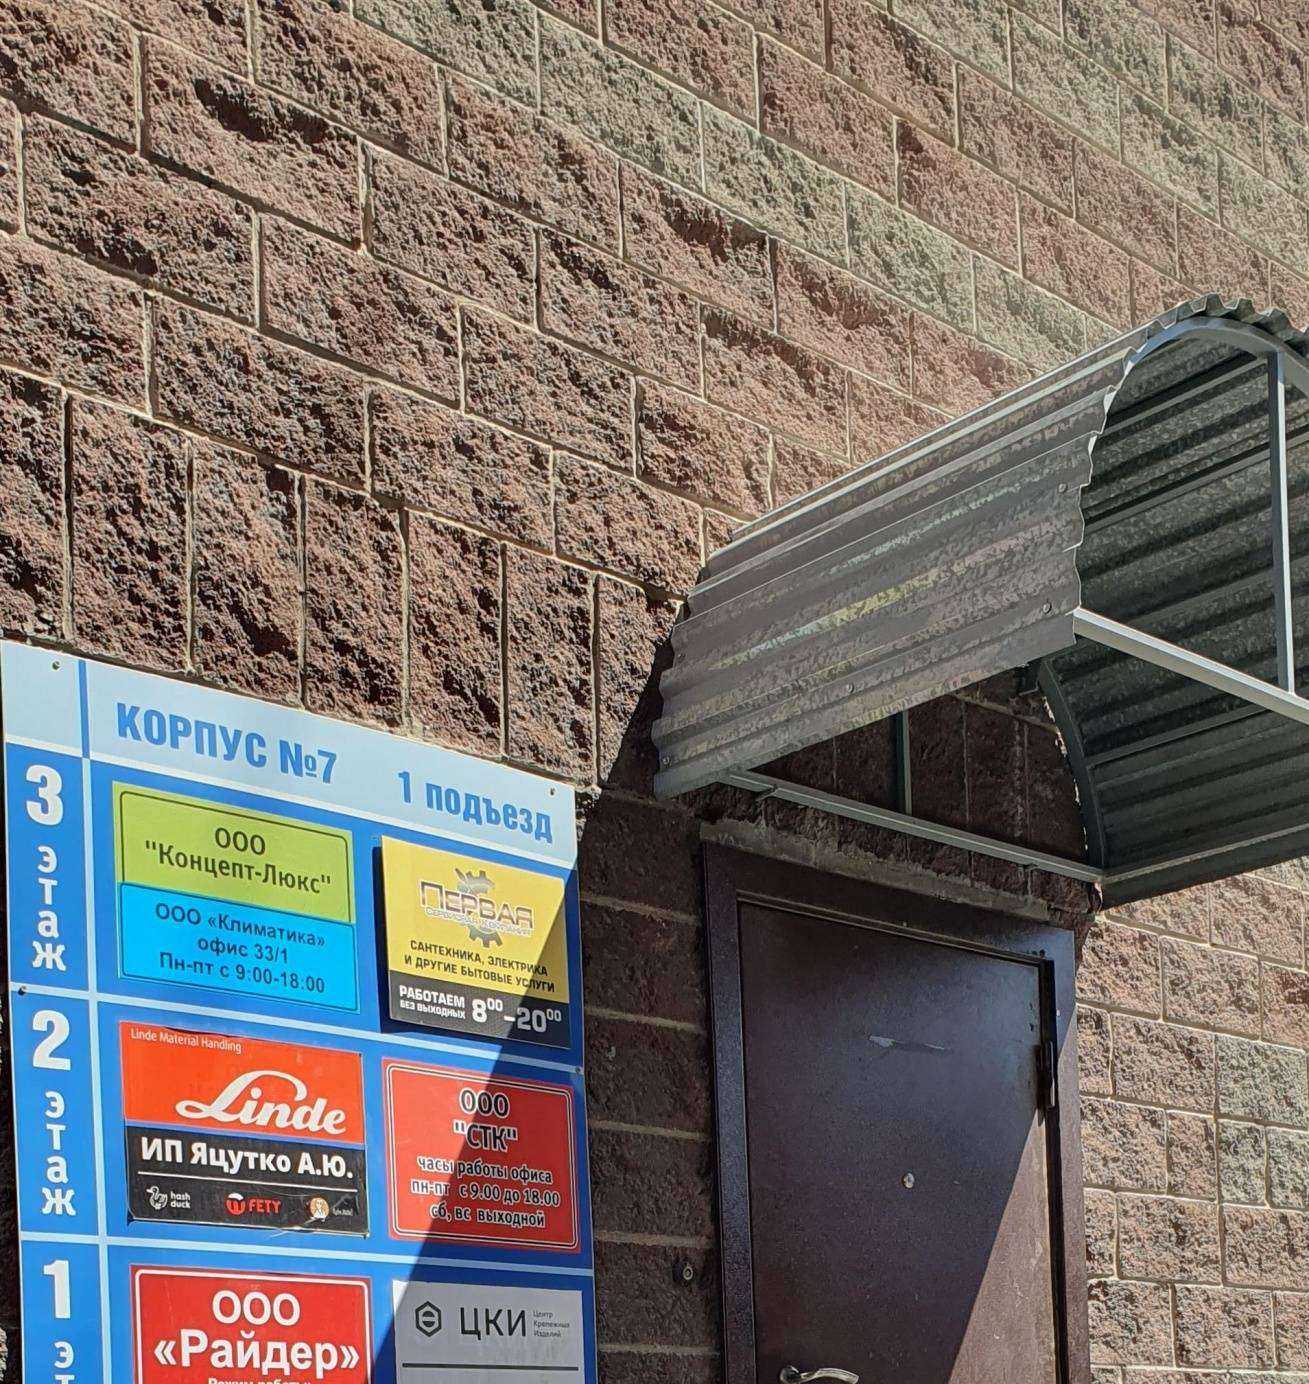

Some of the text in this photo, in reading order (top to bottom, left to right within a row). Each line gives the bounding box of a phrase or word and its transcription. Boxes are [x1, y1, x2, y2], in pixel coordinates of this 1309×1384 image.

[117, 703, 337, 784] КОРПУС №7
[26, 765, 63, 825] 3
[398, 771, 553, 843] 1 подъезд
[215, 828, 266, 855] ООО
[145, 840, 331, 894] "Концепт-Люкс"
[32, 846, 66, 971] этаж
[420, 881, 533, 929] ПЕРВАЯ
[156, 903, 325, 946] ООО «Климатика»
[198, 937, 288, 963] офис 33/1
[410, 940, 548, 977] САНТЕХНИКА, ЭЛЕКТРИКА
[160, 952, 324, 993] Пн-пт с 9:00-18:00
[404, 955, 555, 992] И ДРУГИЕ БЫТОВЫЕ УСЛУГИ
[399, 984, 465, 1009] РАБОТАЕМ
[400, 1000, 466, 1019] БЕЗ ВЫХОДНЫХ
[32, 1010, 71, 1071] 2
[131, 1028, 242, 1054] Linde Material Handling
[175, 1070, 347, 1134] Linde
[459, 1087, 510, 1119] ООО
[41, 1090, 76, 1216] этаж
[453, 1119, 518, 1152] "СТК"
[141, 1137, 354, 1178] ИП Яцутко А.Ю.
[417, 1156, 553, 1184] часы работы офиса
[170, 1191, 191, 1200] hash
[170, 1200, 191, 1209] duck
[248, 1199, 281, 1214] FETY
[411, 1178, 560, 1206] пн-пт с 9.00 до 18.00
[430, 1201, 545, 1228] сб, вс выходной
[43, 1260, 71, 1319] 1
[212, 1289, 301, 1326] ООО
[460, 1307, 527, 1341] ЦКИ
[154, 1328, 360, 1379] «Райдер»
